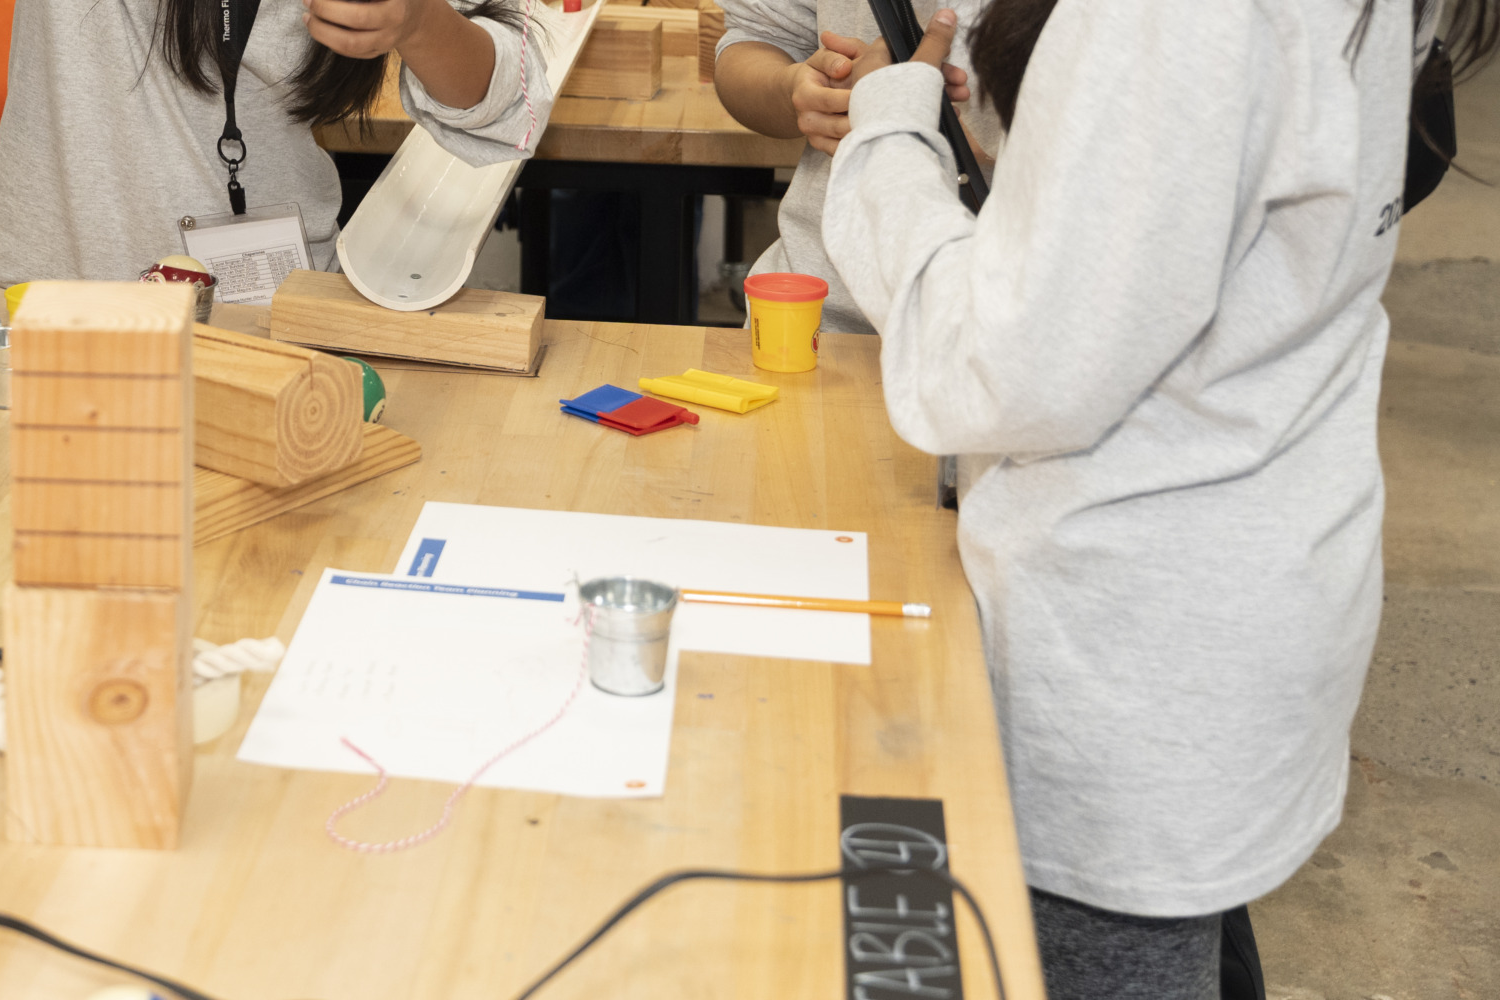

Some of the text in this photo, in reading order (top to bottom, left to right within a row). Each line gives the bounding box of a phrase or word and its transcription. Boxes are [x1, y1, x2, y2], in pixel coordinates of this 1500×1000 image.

[222, 9, 231, 42] Thermo
[344, 577, 519, 598] Chain Reaction Team Planning
[848, 885, 957, 1000] ABLE
